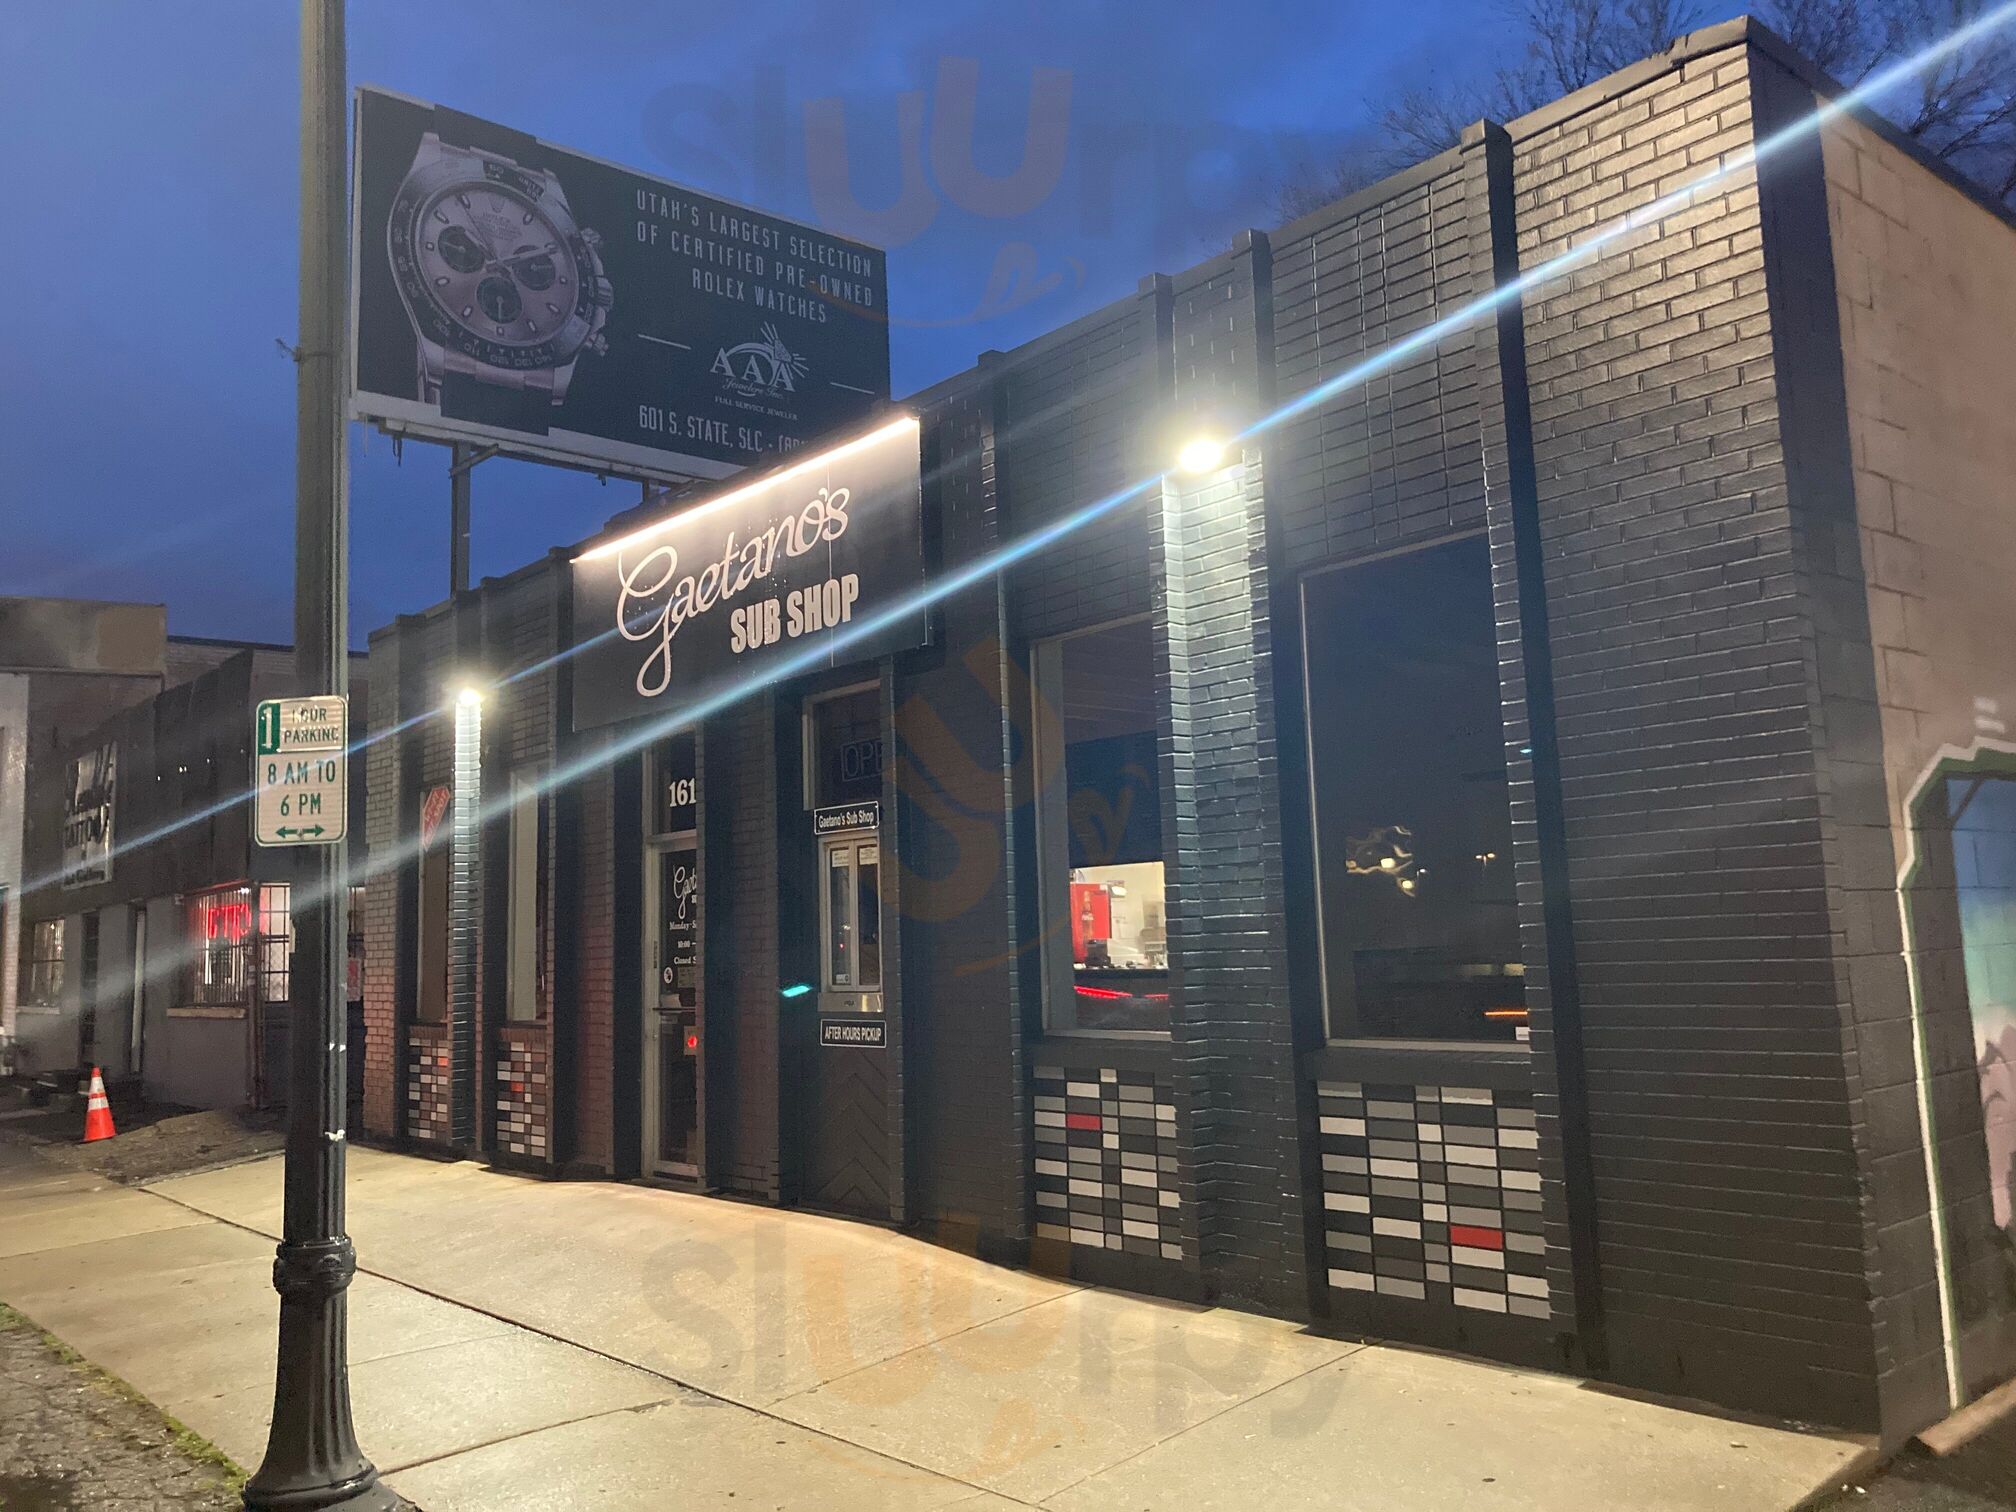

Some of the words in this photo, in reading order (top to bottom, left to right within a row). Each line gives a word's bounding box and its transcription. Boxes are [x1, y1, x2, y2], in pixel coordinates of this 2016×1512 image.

[637, 189, 699, 226] UTAH'S
[710, 212, 780, 250] LARGEST
[790, 236, 871, 278] SELECTION
[637, 221, 658, 245] OF
[671, 231, 764, 275] CERTIFIED
[776, 262, 872, 307] PRE-OWNED
[692, 268, 745, 301] ROLEX
[755, 286, 827, 323] WATCHES
[639, 405, 663, 432] 601
[669, 411, 682, 436] S.
[687, 416, 733, 448] STATE,
[738, 427, 763, 452] SLC
[735, 401, 764, 413] SERVICE
[616, 487, 850, 697] Gaetano's
[730, 599, 781, 653] SUB
[787, 574, 859, 638] SHOP
[262, 706, 273, 749] 1
[267, 763, 277, 785] 8
[284, 761, 308, 785] AM
[316, 760, 336, 783] TO
[280, 794, 289, 817] 6
[299, 792, 321, 816] PM
[858, 809, 874, 825] Shop
[825, 1026, 841, 1040] AFTER
[842, 1026, 860, 1041] HOURS
[861, 1026, 881, 1041] PICKUP
